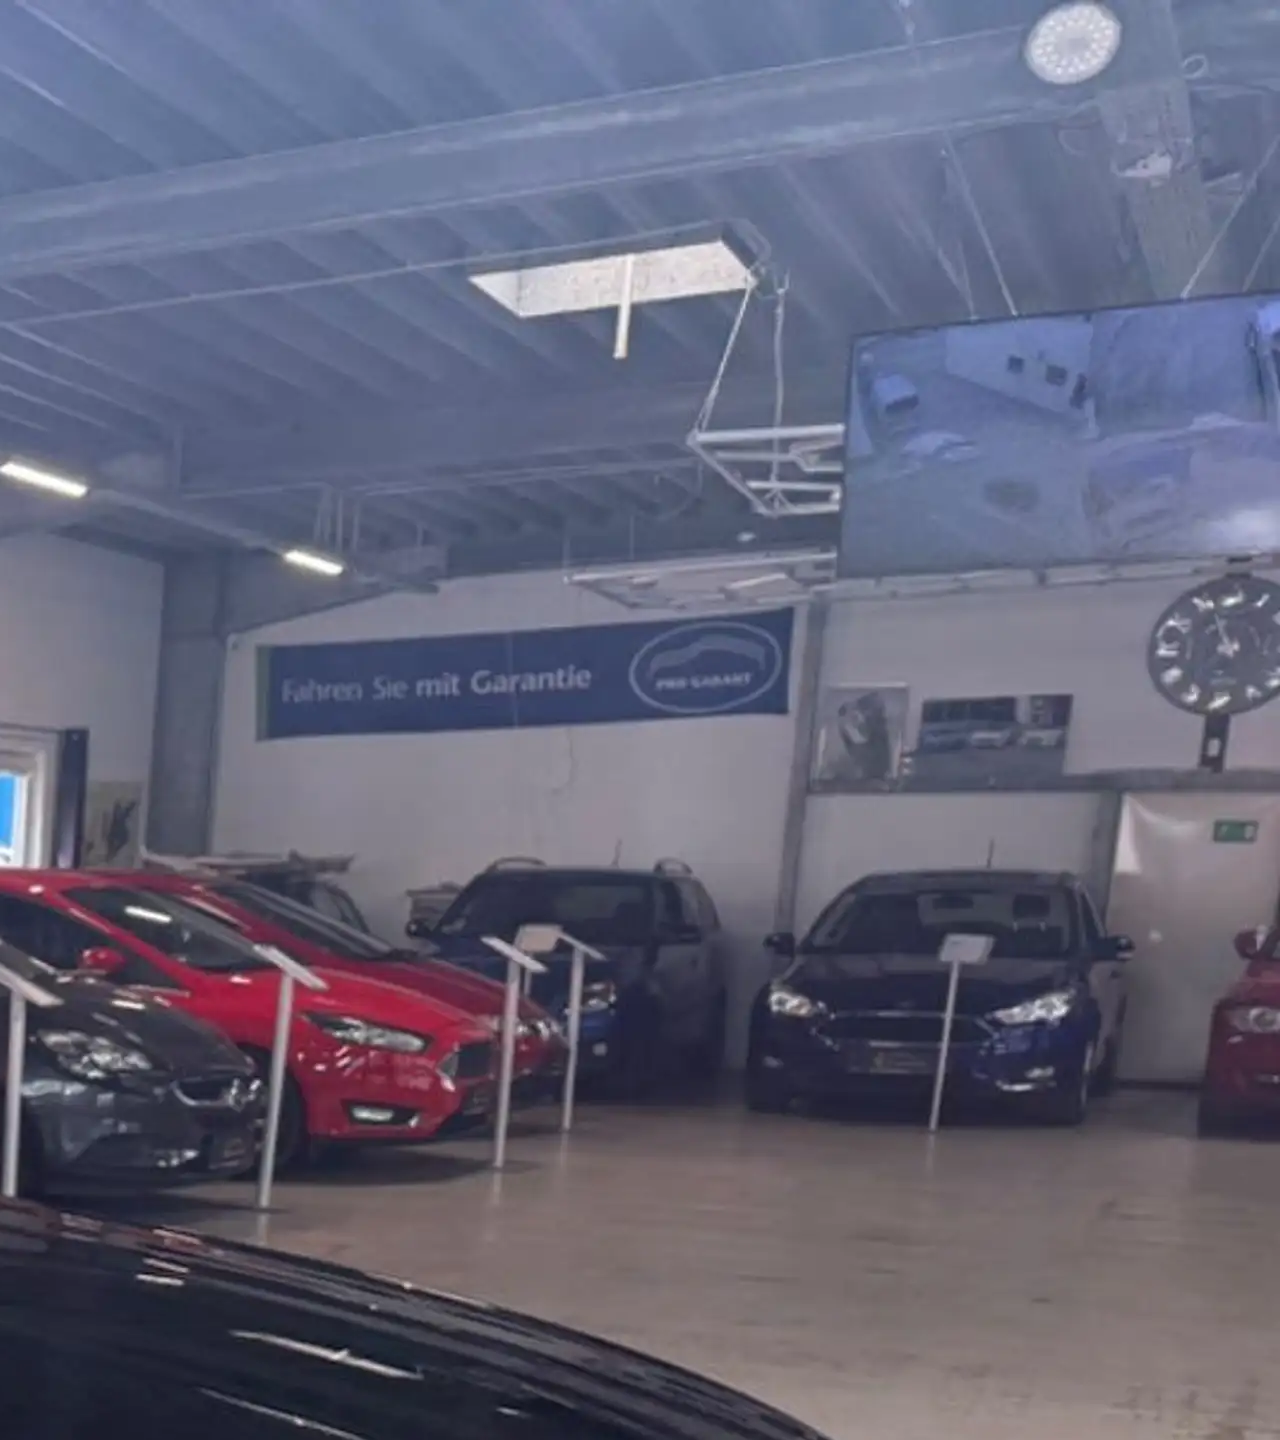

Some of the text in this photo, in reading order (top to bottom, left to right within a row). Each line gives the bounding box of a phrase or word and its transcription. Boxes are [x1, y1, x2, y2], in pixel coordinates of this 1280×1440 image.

[282, 665, 592, 703] Fahren Sie mit Garantie
